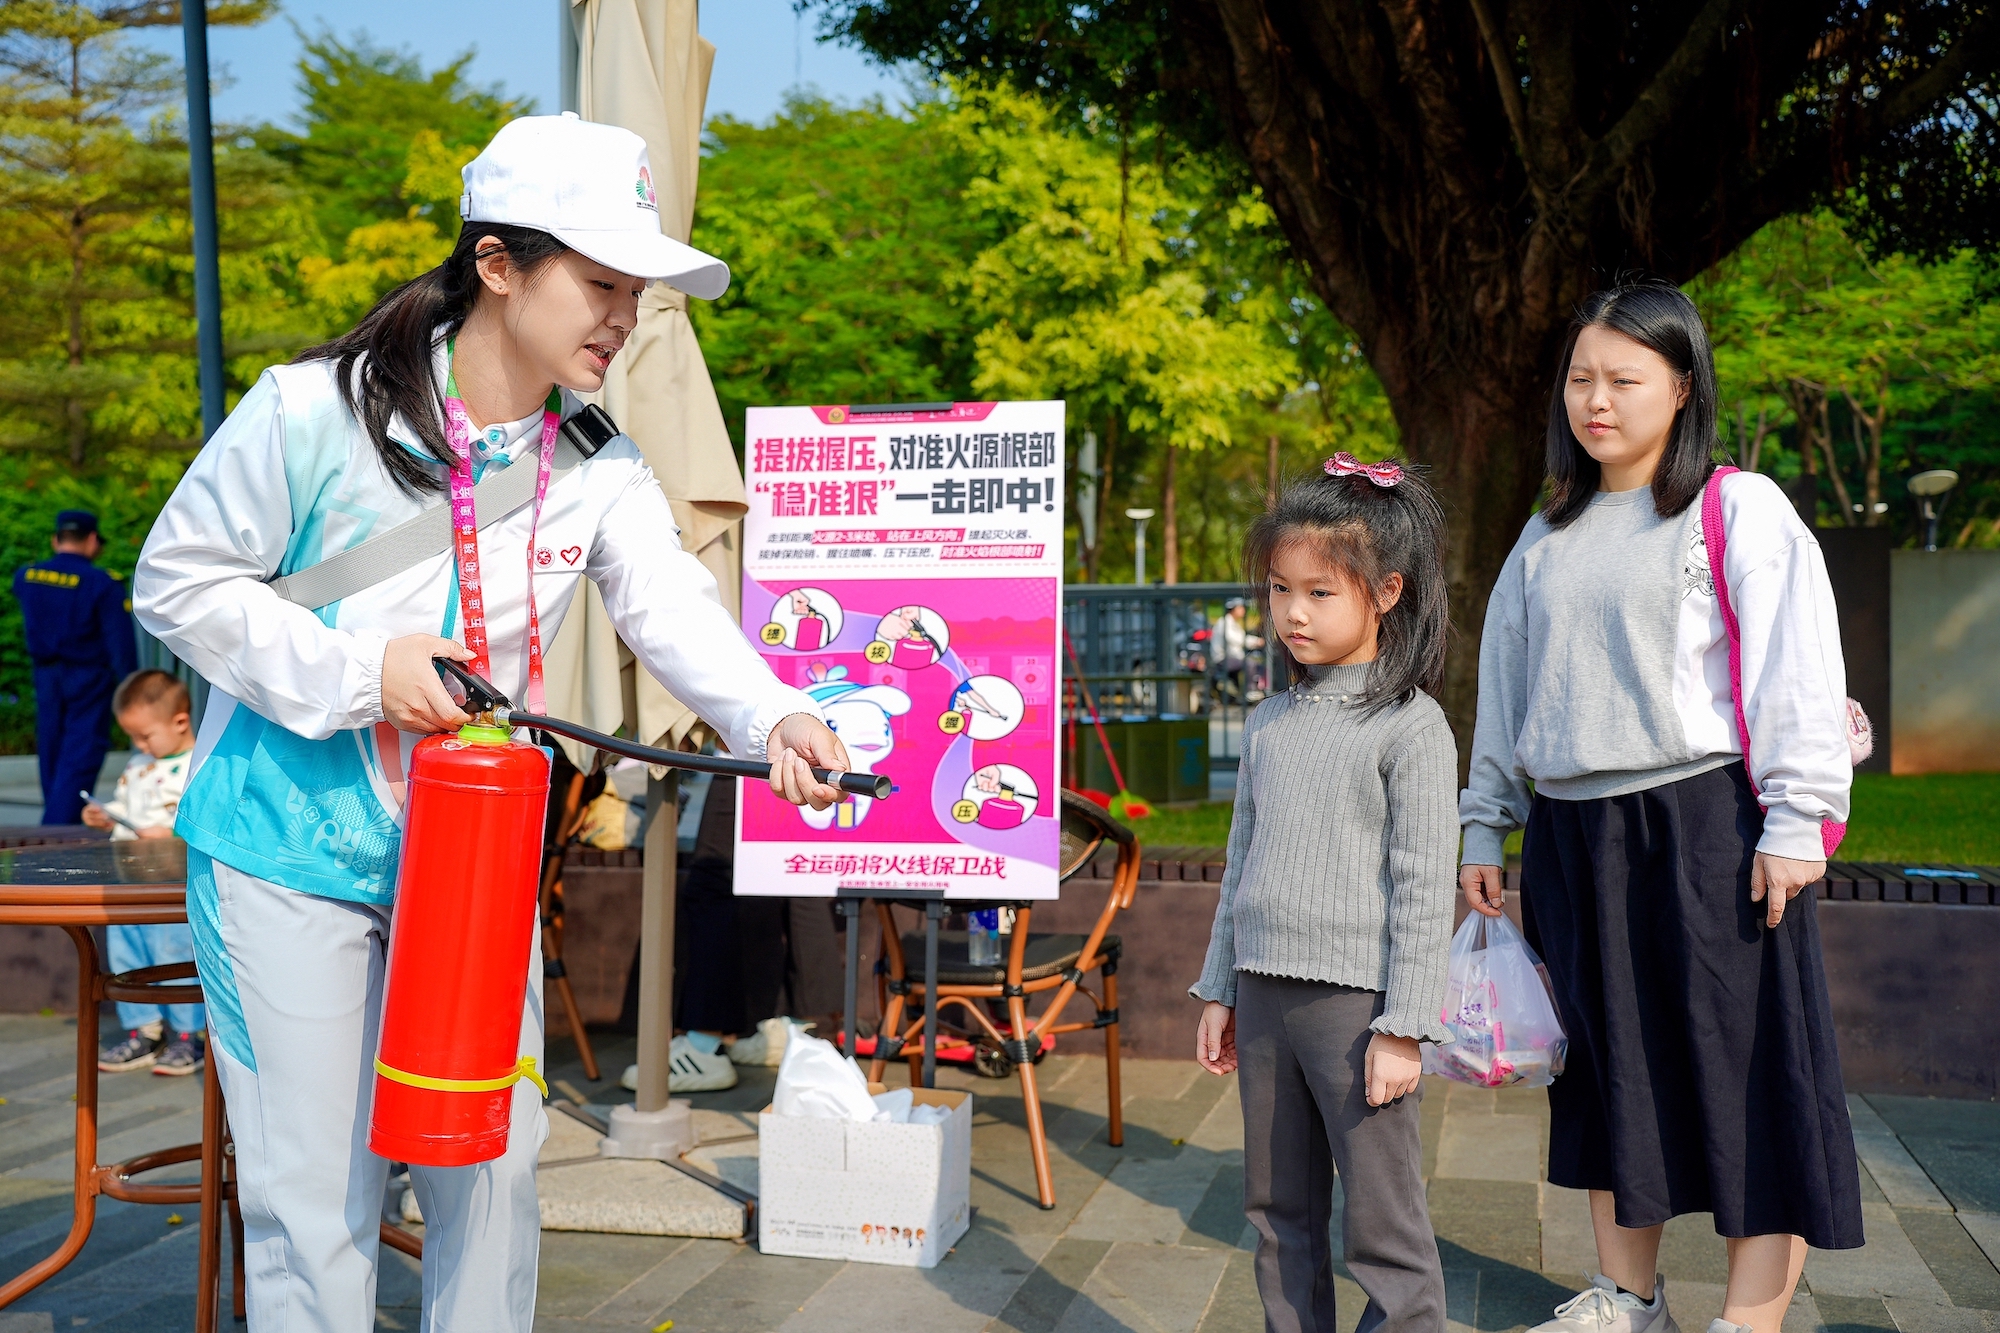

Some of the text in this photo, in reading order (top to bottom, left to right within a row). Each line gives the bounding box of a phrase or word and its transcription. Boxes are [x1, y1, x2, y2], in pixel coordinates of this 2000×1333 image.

[754, 432, 1055, 474] 提拔握压,对准火源根部
[755, 477, 1055, 517] “稳准狠”一击即中!
[957, 805, 973, 818] 压
[784, 854, 1007, 879] 全运萌将火线保卫战
